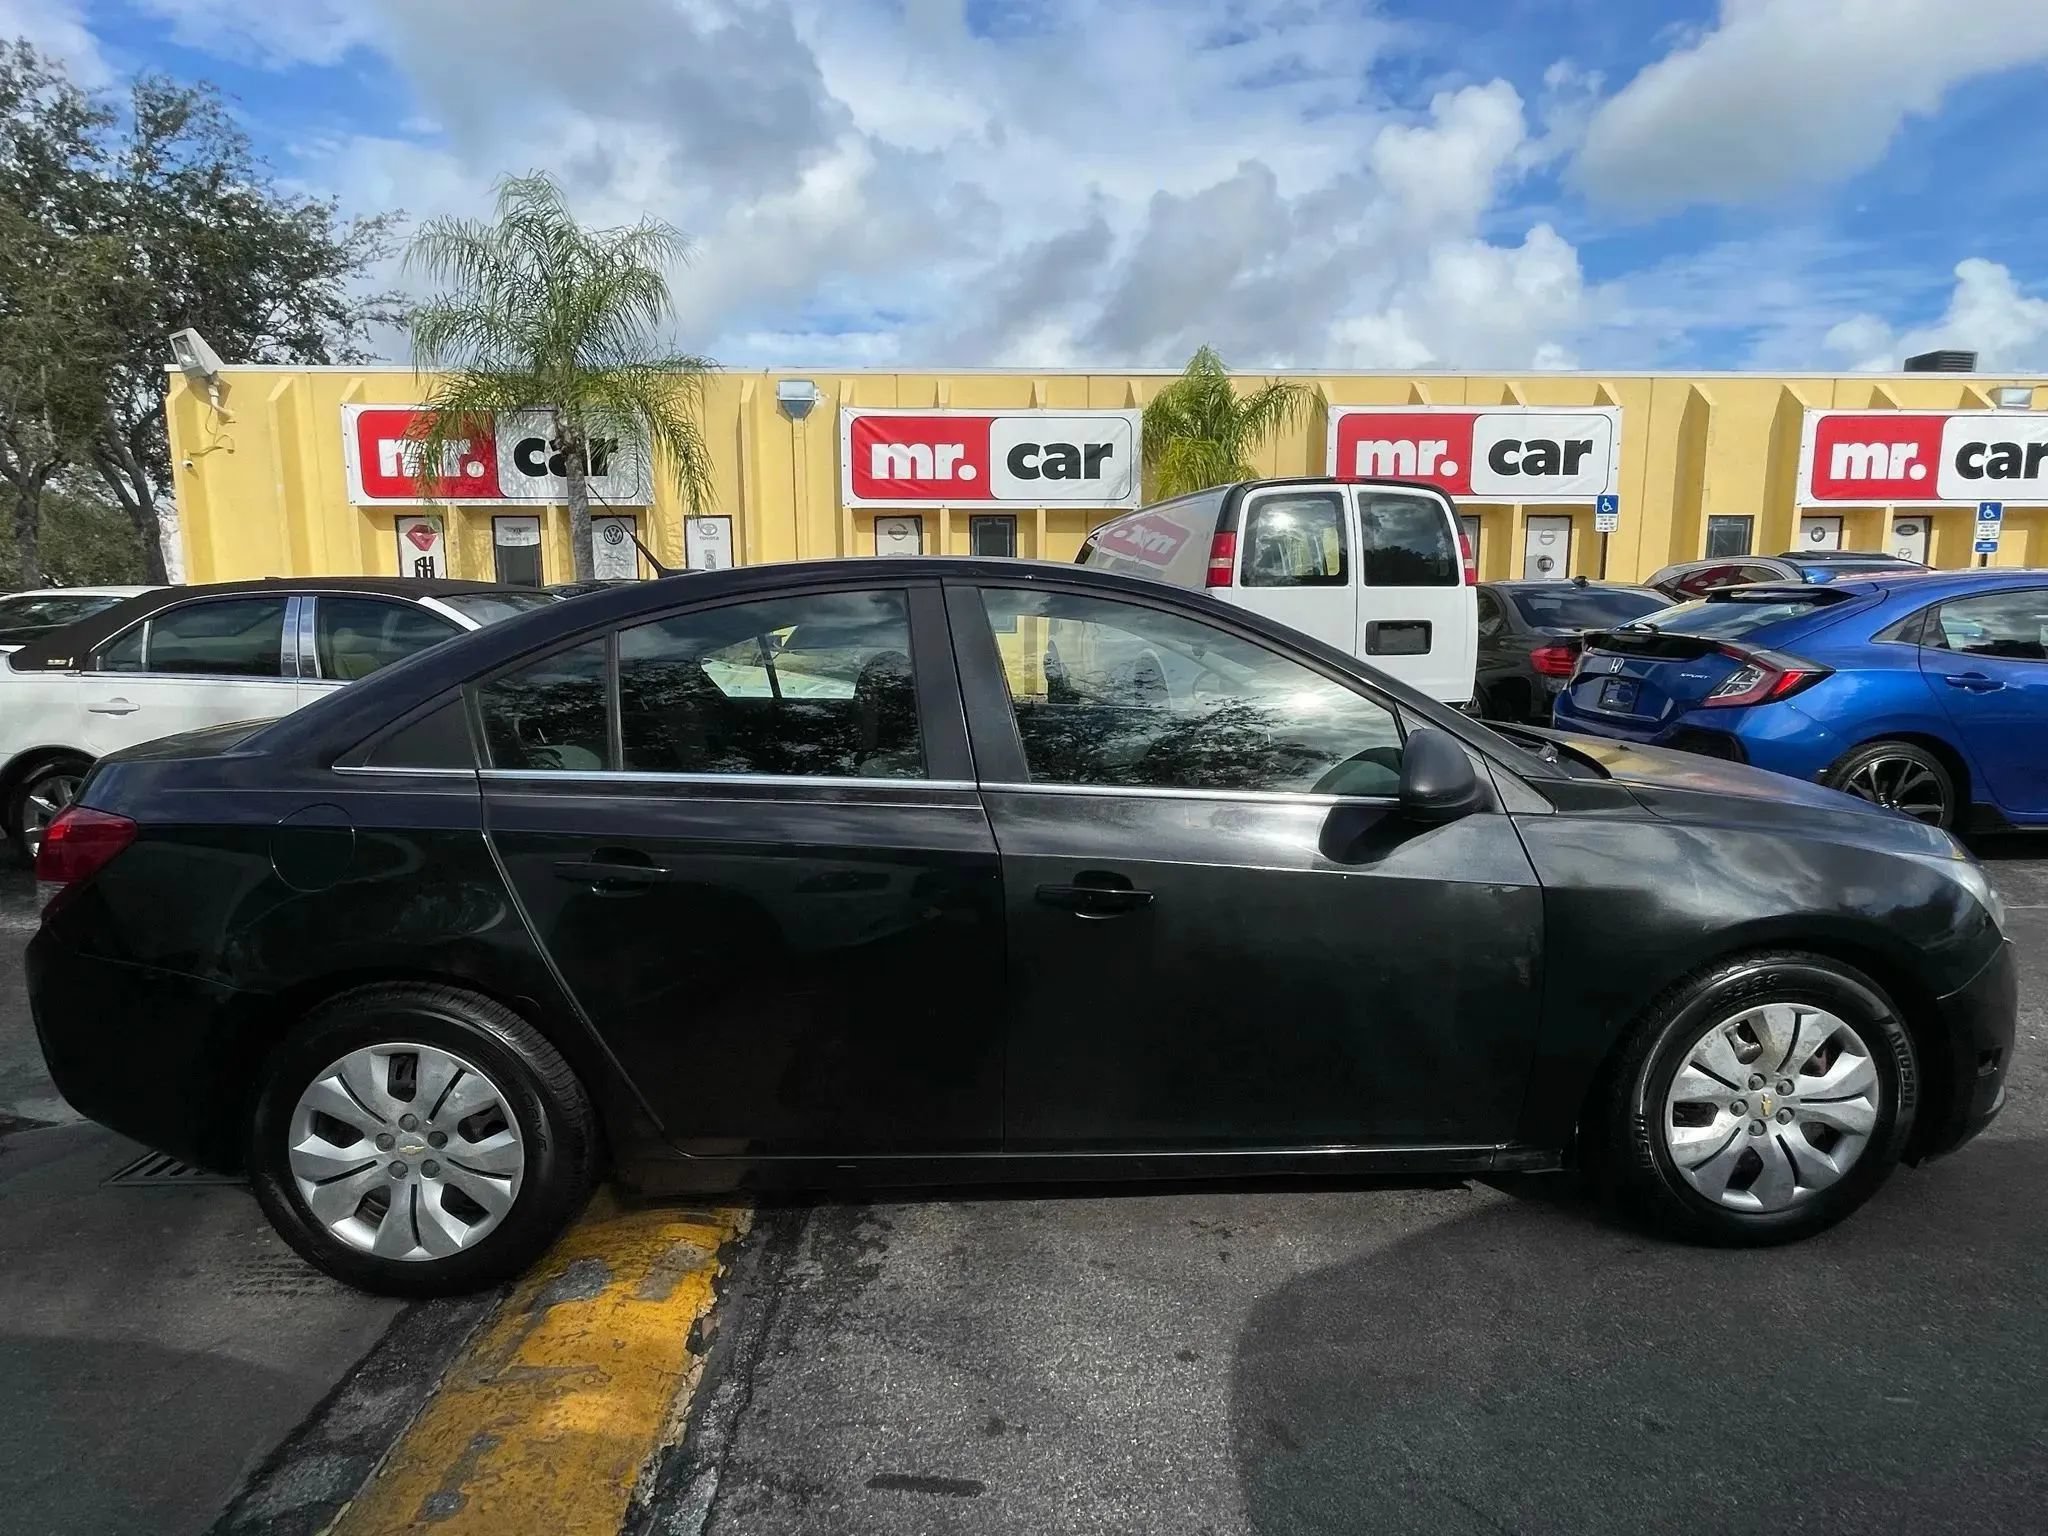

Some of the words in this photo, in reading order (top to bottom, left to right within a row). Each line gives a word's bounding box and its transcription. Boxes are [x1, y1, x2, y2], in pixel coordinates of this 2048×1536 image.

[871, 442, 977, 481] mr.
[1007, 442, 1113, 480] car
[1356, 439, 1459, 477] mr.
[1488, 438, 1593, 476] car
[1830, 441, 1927, 481] mr.
[1955, 441, 2048, 480] car
